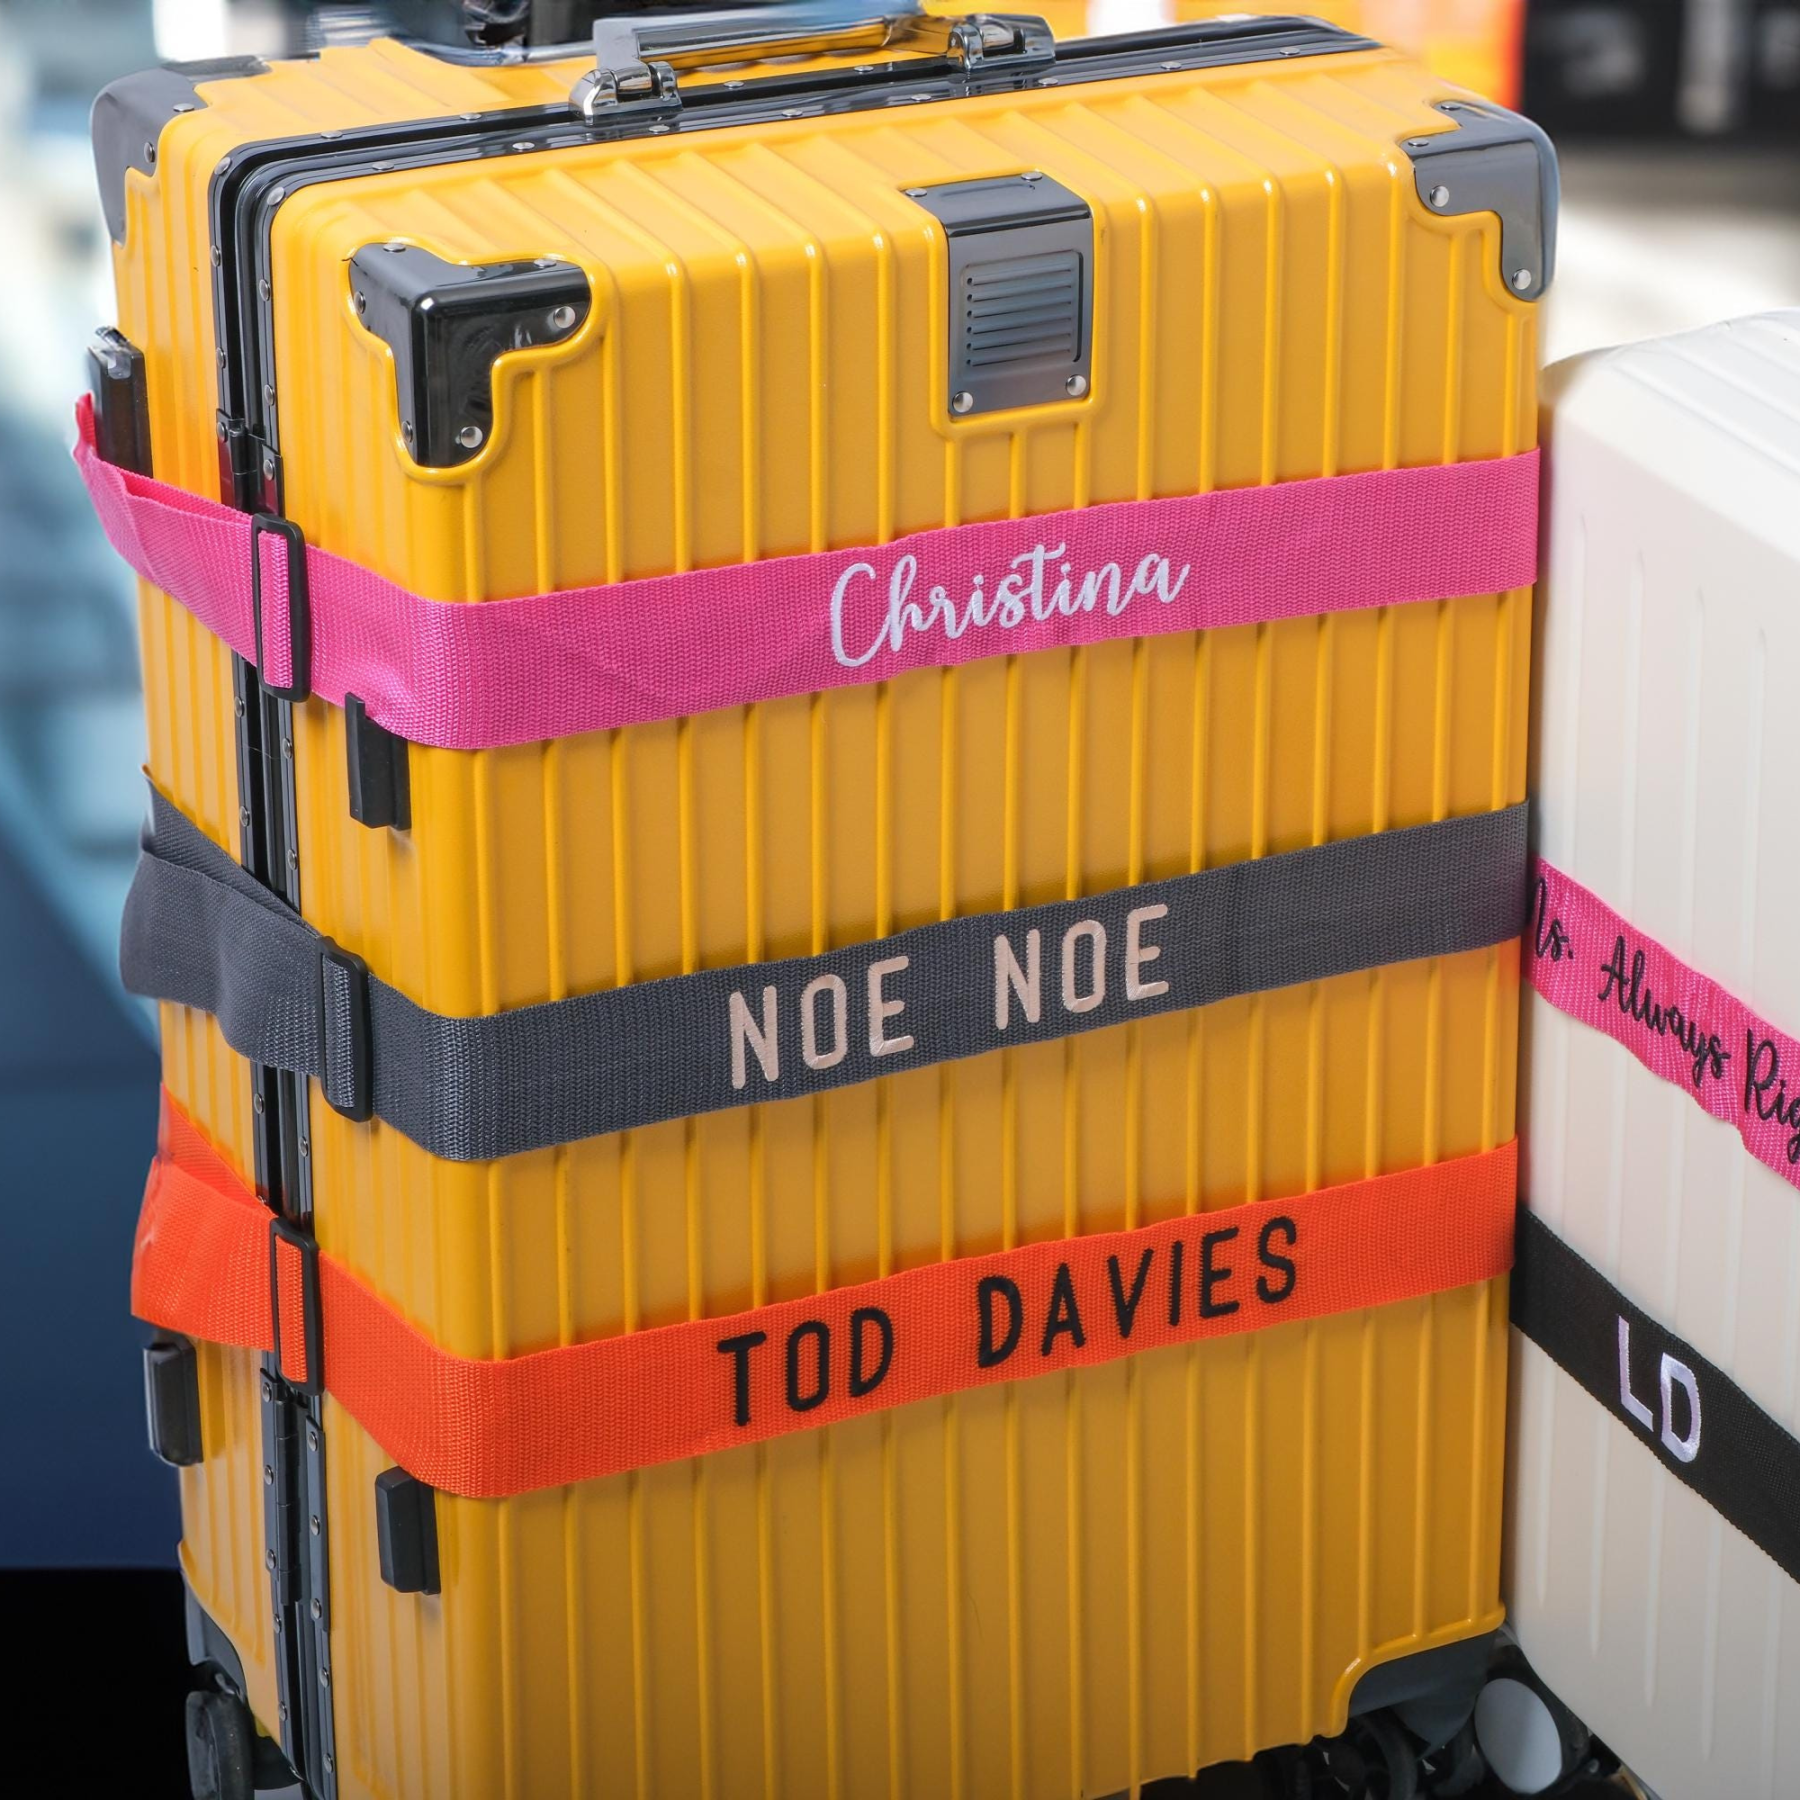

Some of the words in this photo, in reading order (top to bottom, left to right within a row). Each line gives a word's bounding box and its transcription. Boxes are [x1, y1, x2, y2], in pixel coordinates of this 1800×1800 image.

[830, 542, 1191, 668] Christina
[729, 955, 915, 1090] NOE
[994, 903, 1170, 1030] NOE
[1597, 935, 1731, 1087] Always
[717, 1306, 894, 1427] TOD
[976, 1216, 1297, 1369] DAVIES
[1617, 1314, 1701, 1463] LD
